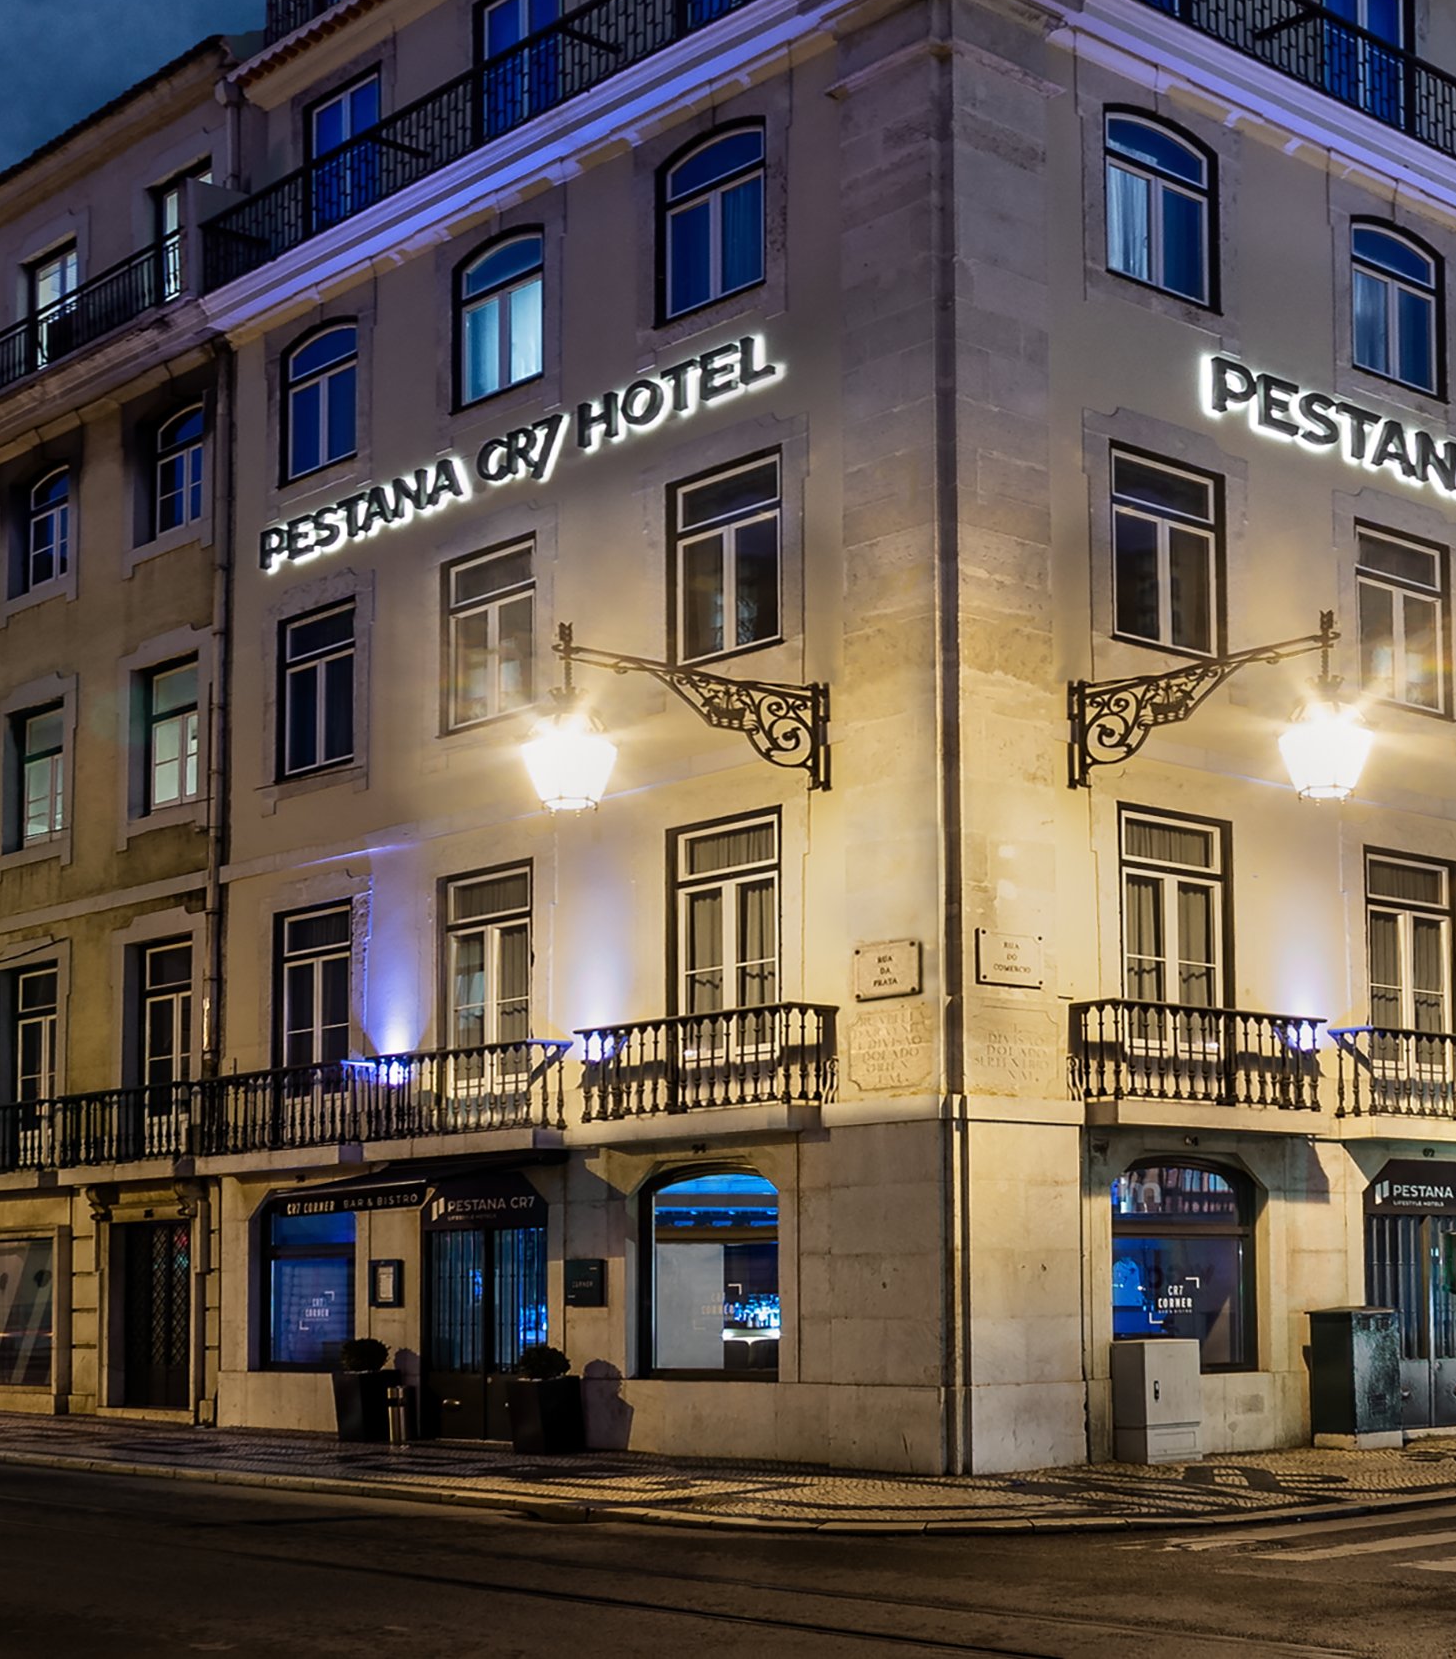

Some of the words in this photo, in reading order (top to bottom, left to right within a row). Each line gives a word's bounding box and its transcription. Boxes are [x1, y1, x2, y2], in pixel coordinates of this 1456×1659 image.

[258, 457, 466, 572] PESTANA
[477, 413, 567, 482] CR7
[577, 336, 779, 449] HOTEL
[1004, 942, 1019, 950] RUA
[877, 955, 893, 964] RUA
[1007, 953, 1017, 961] DO
[880, 966, 891, 975] DA
[873, 977, 899, 987] PRATA
[1393, 1184, 1454, 1199] PESTANA
[287, 1203, 301, 1215] CR7
[303, 1200, 335, 1214] CORNER
[343, 1199, 363, 1209] BAR
[376, 1193, 419, 1207] BISTRO
[447, 1197, 507, 1213] PESTANA
[509, 1195, 535, 1209] CR7
[1168, 1285, 1183, 1296] CR7
[1157, 1297, 1192, 1308] CORNER
